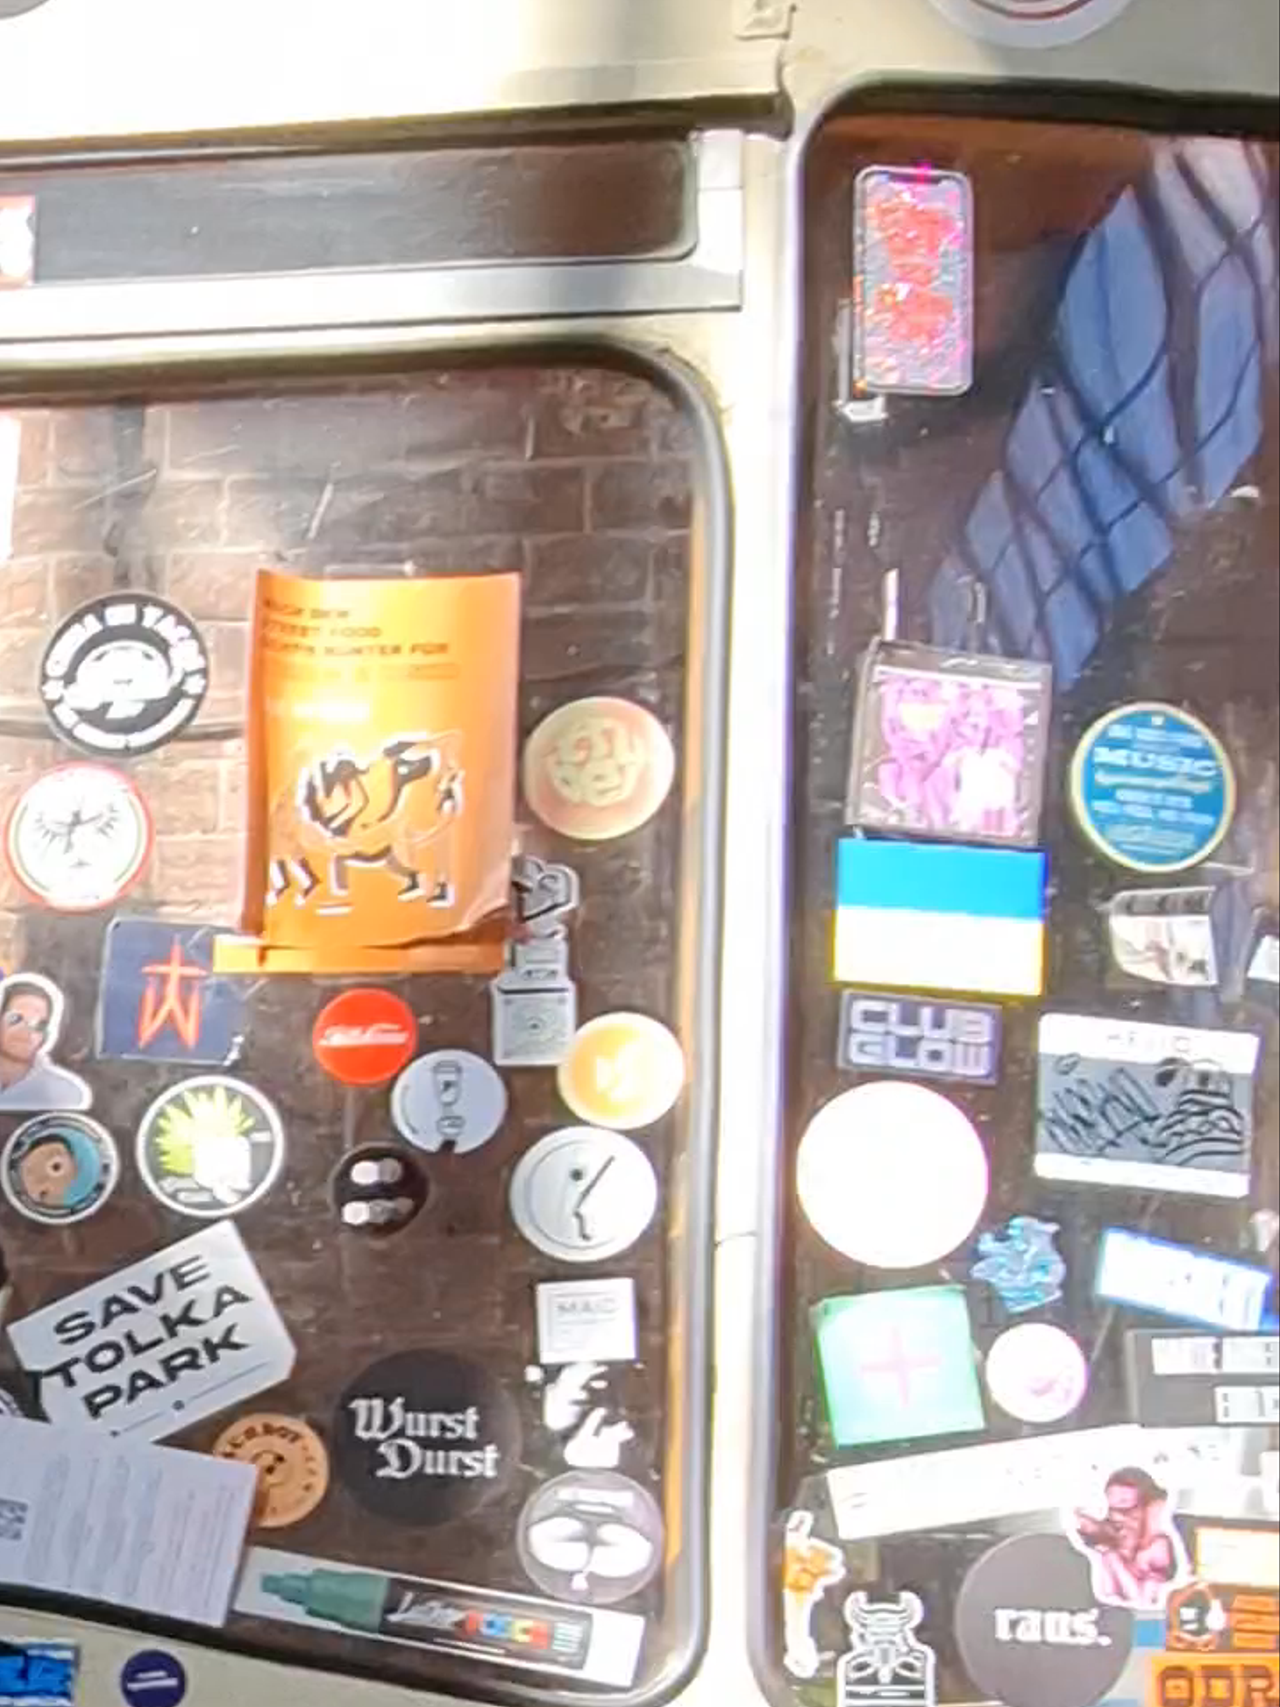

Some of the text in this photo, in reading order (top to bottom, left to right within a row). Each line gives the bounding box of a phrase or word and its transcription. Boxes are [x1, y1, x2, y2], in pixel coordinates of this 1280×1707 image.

[43, 1284, 254, 1388] TOLKA
[52, 1253, 214, 1347] SAVE
[80, 1322, 251, 1420] PARK
[348, 1396, 481, 1440] Wurst
[376, 1438, 500, 1481] Durst
